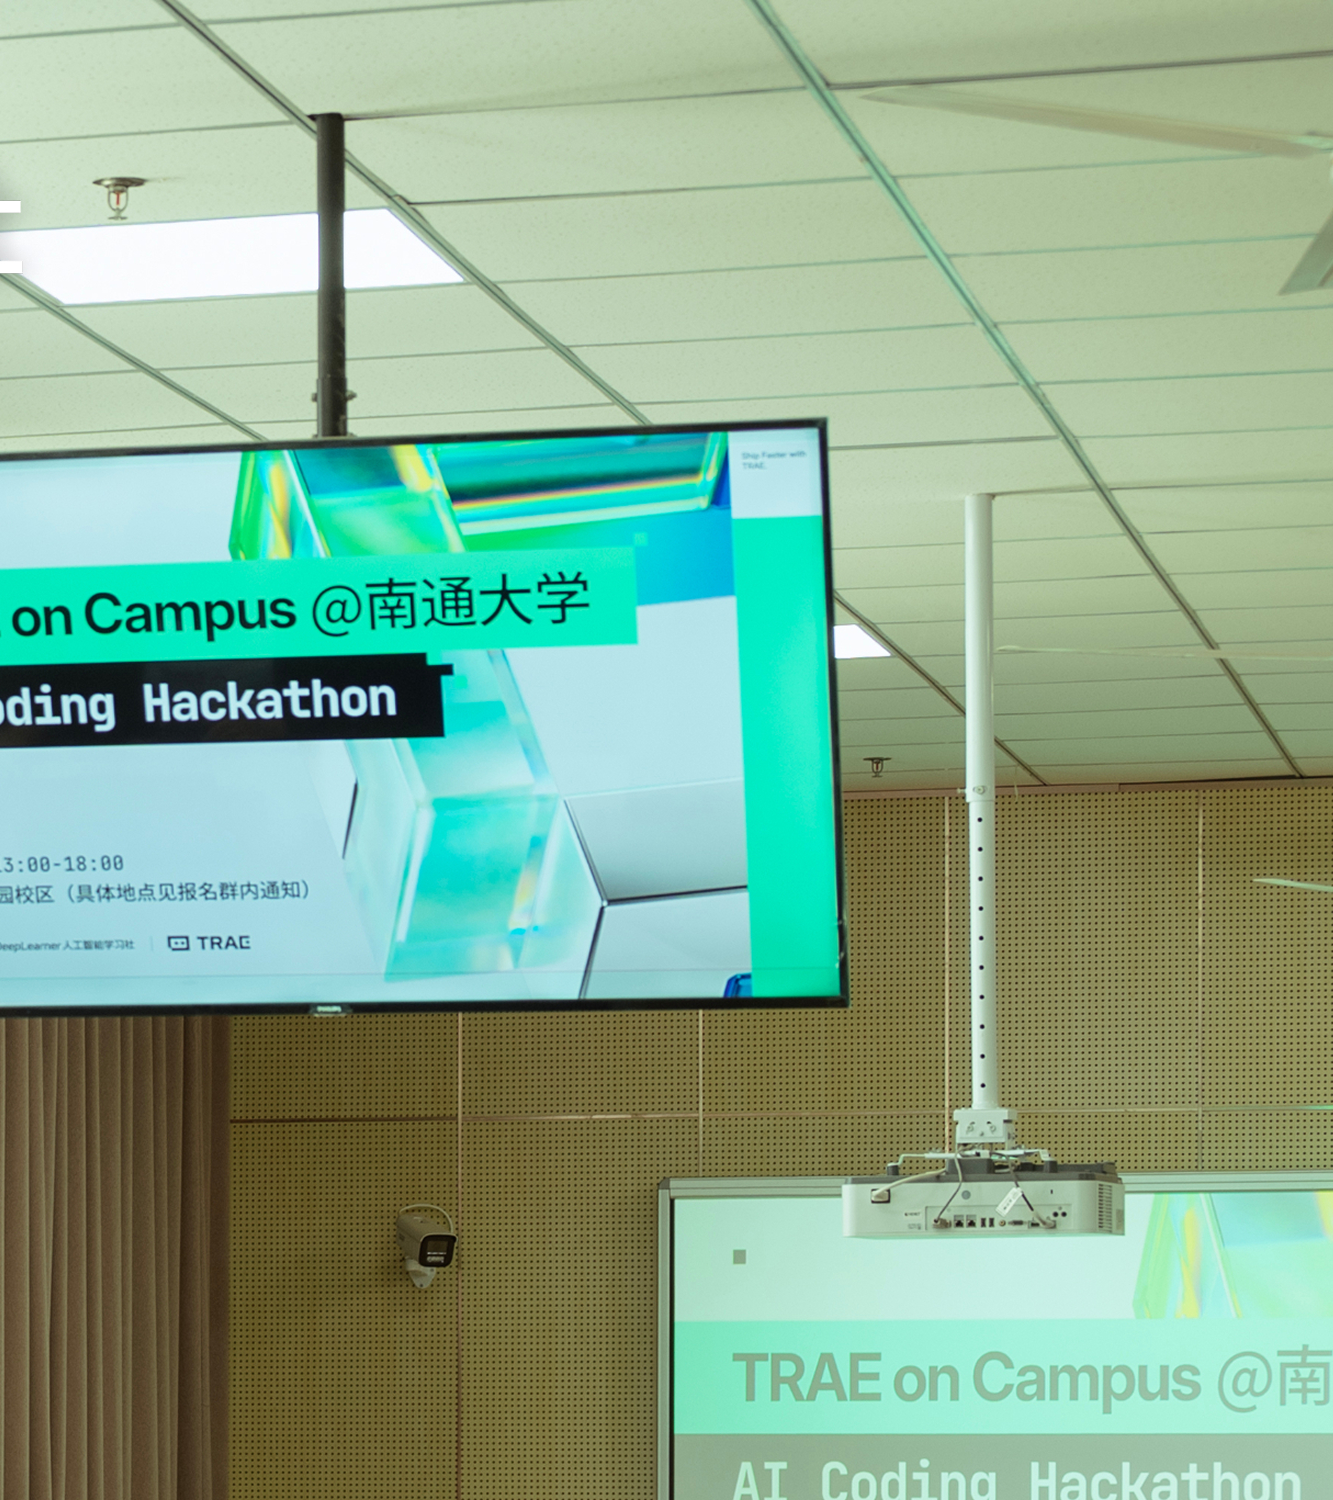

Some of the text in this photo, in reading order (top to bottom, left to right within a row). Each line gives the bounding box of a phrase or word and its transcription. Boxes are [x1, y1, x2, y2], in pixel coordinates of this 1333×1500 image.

[11, 605, 73, 637] on
[84, 592, 297, 642] Campus
[312, 571, 590, 638] @南通大学
[143, 678, 397, 722] Hackathon
[63, 939, 135, 951] 人工智能学习社
[196, 935, 251, 950] TRAE
[733, 1344, 1333, 1415] TRAE on Campus @南
